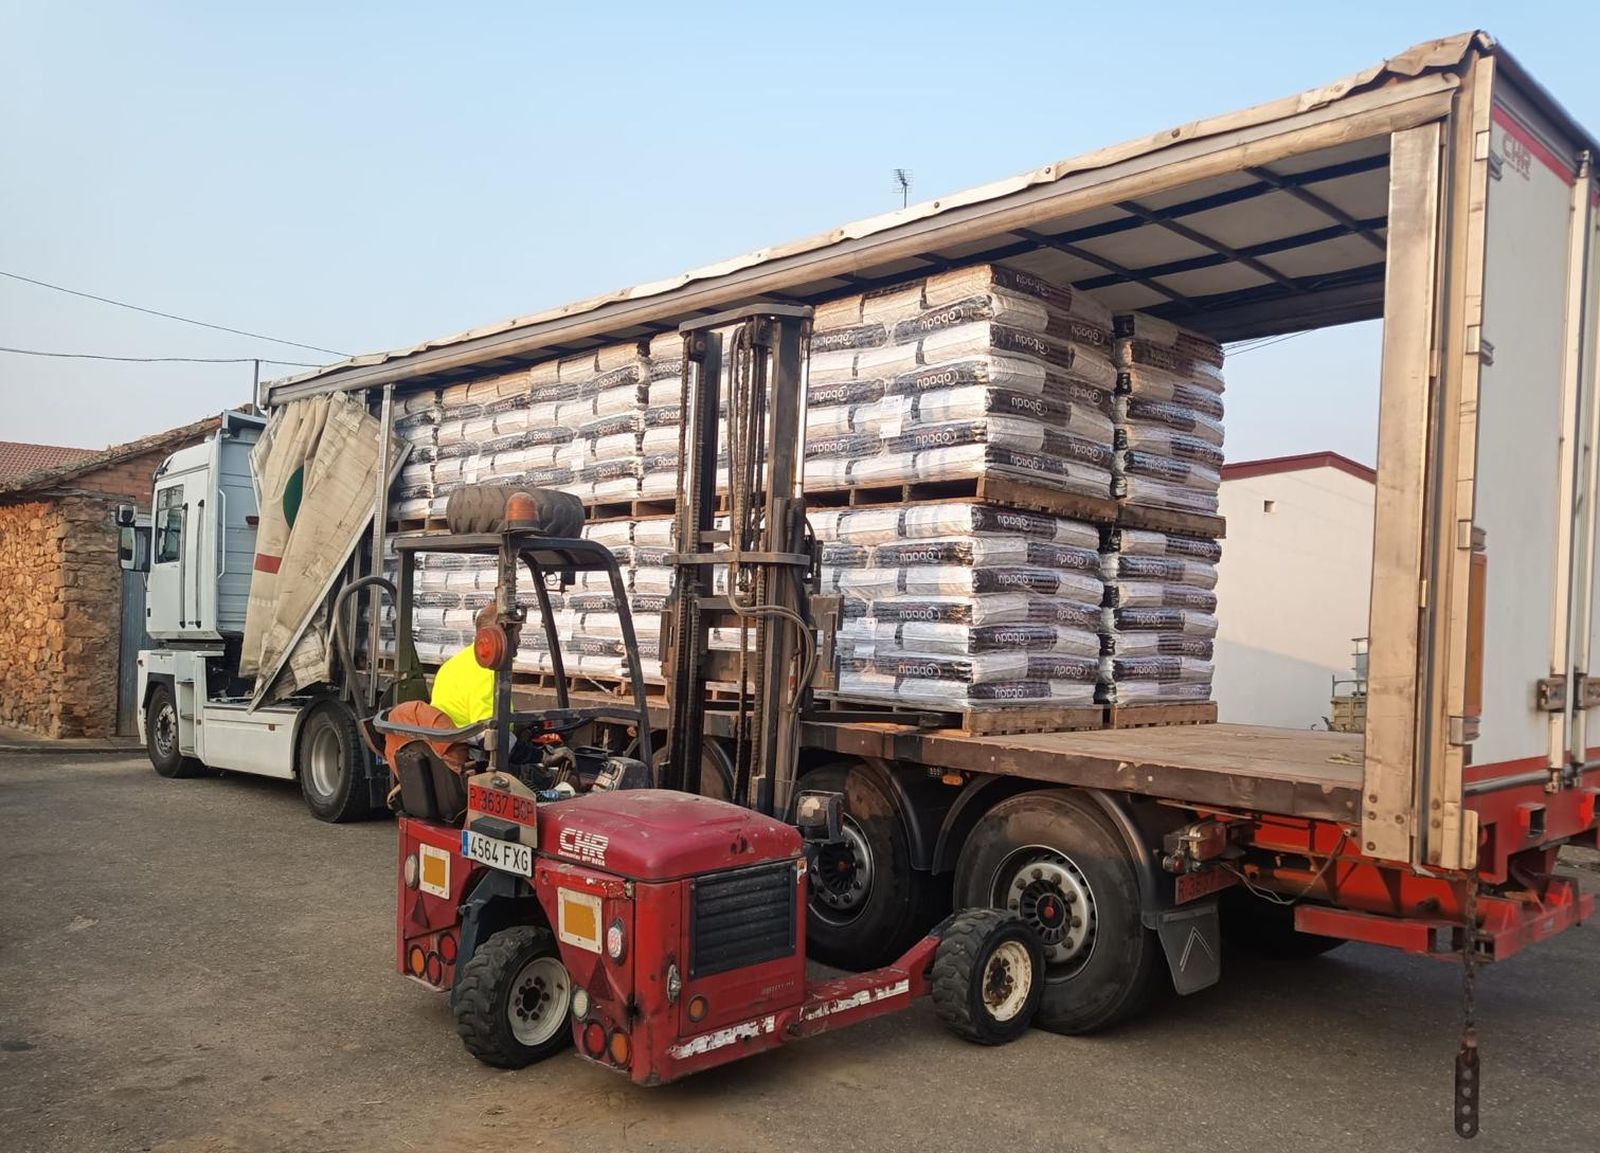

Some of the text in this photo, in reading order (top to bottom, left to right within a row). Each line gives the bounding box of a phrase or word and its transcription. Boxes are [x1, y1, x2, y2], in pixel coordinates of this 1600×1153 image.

[1503, 133, 1532, 175] CHR
[469, 787, 477, 808] R
[480, 790, 508, 815] 3637
[470, 836, 499, 864] 4564
[503, 845, 529, 871] FXG
[560, 827, 609, 859] CHR
